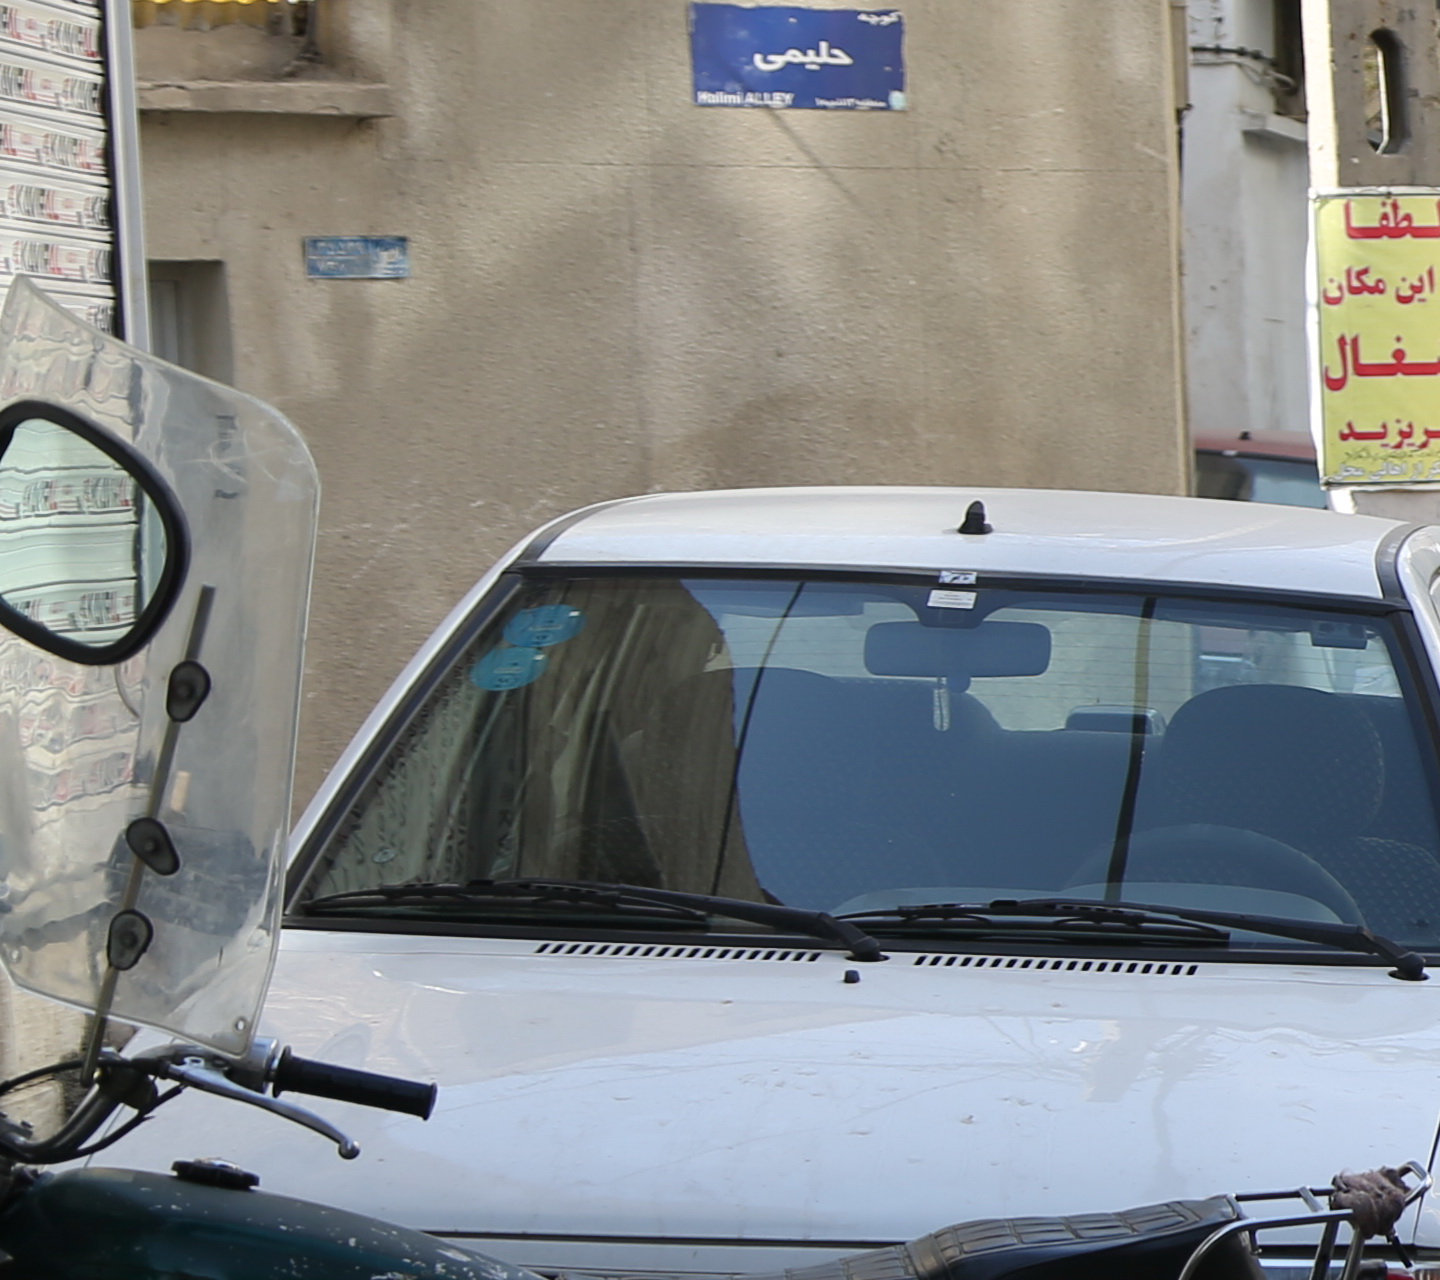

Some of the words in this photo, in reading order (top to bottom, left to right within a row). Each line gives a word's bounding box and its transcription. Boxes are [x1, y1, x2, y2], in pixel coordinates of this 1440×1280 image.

[753, 40, 854, 72] حلیمی
[744, 91, 795, 105] ALLEY
[1322, 266, 1387, 306] مکان
[1395, 266, 1436, 304] این
